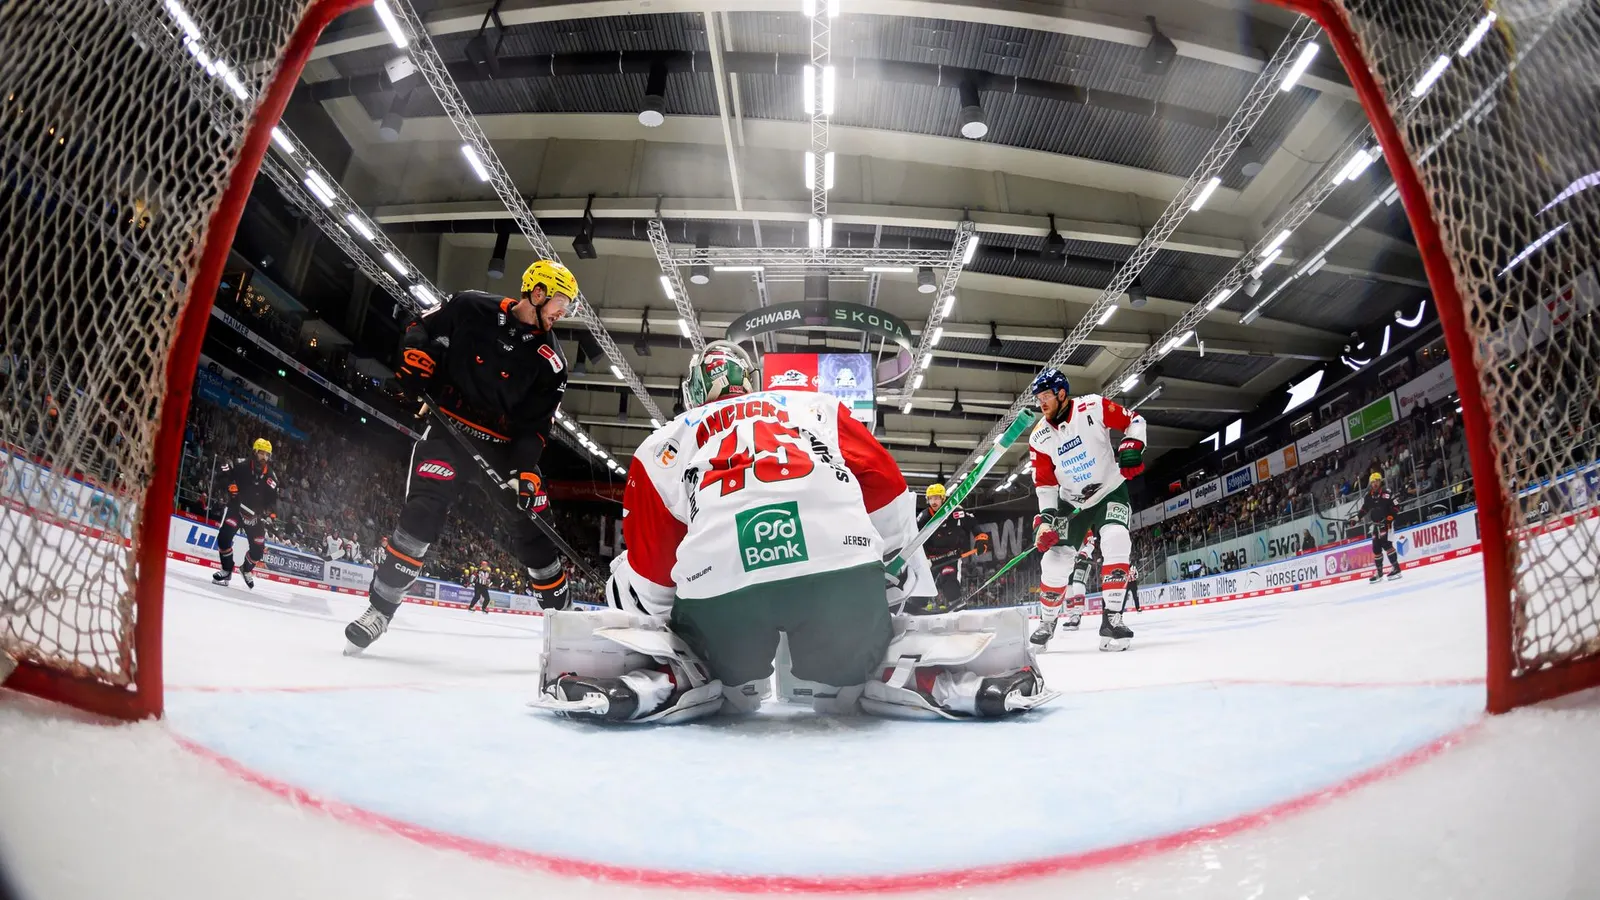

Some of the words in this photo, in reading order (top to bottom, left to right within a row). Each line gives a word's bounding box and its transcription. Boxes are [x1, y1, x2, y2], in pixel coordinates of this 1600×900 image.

[223, 313, 250, 338] HAIMER
[745, 309, 801, 332] SCHWABA
[710, 365, 725, 377] AEV
[1086, 414, 1094, 427] A
[1058, 437, 1082, 455] HAIMER
[699, 420, 815, 497] 45
[1061, 451, 1087, 468] Immer
[1072, 457, 1097, 474] deiner
[419, 462, 455, 478] HOLY
[1073, 471, 1092, 483] Seite
[1195, 481, 1218, 499] delphis
[1107, 512, 1127, 523] Bank
[186, 525, 219, 551] Lu
[754, 518, 797, 543] psd
[1326, 521, 1348, 543] sw
[1412, 520, 1458, 549] WURZER
[843, 535, 871, 548] JER53Y
[1268, 533, 1300, 559] swa
[745, 540, 803, 567] Bank
[692, 565, 712, 580] BAUER
[1265, 570, 1297, 588] HORSE
[1297, 565, 1319, 582] GYM
